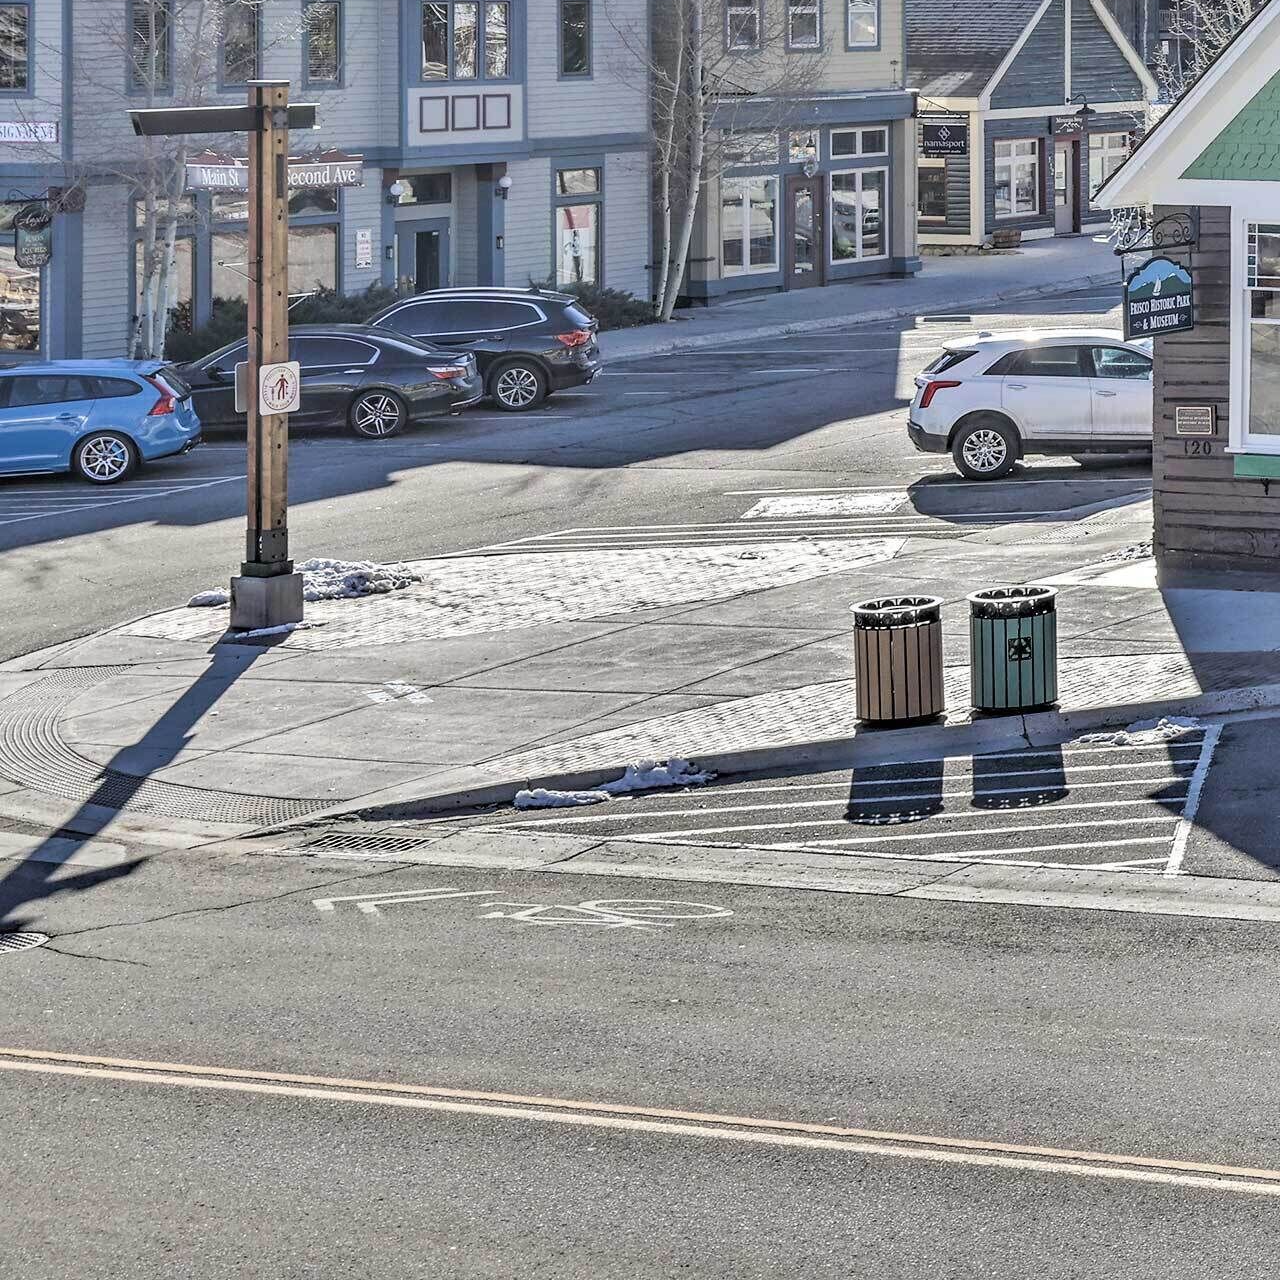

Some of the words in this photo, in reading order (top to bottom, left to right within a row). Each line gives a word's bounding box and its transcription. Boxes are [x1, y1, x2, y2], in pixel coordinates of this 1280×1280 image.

[924, 140, 965, 149] namasport
[202, 168, 227, 186] Main
[228, 169, 240, 186] St
[333, 167, 356, 184] Ave
[1130, 301, 1150, 315] FRISCO
[1150, 297, 1176, 312] HISTORIC
[1176, 295, 1190, 308] PARK
[1142, 318, 1149, 330] &
[1150, 313, 1179, 329] MUSEUM
[1184, 440, 1212, 455] 120
